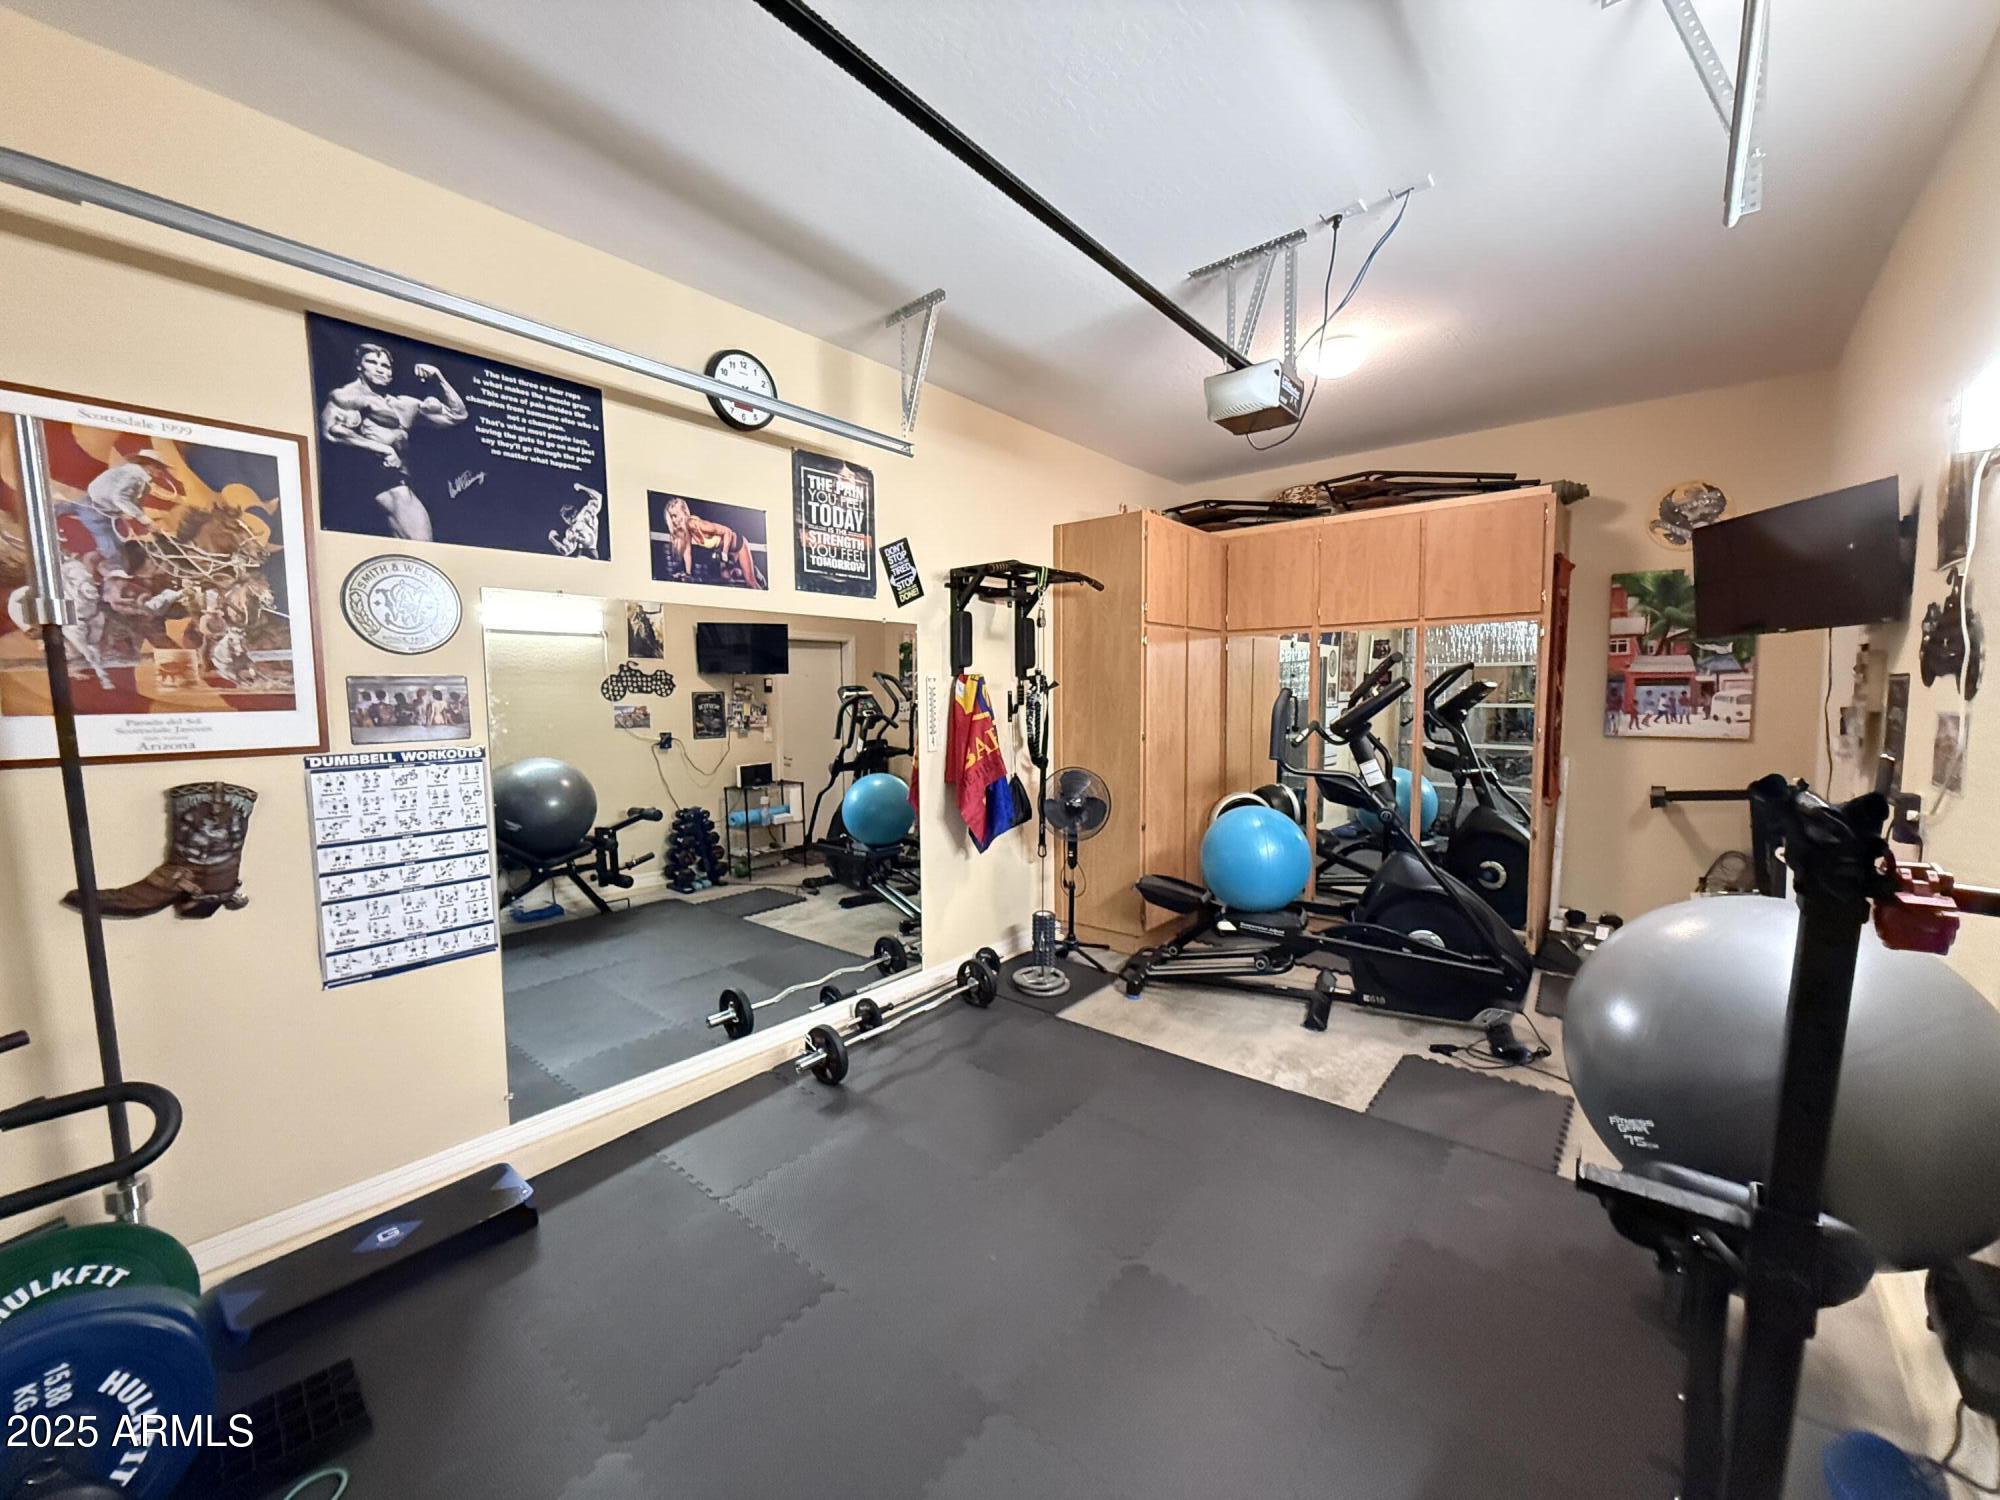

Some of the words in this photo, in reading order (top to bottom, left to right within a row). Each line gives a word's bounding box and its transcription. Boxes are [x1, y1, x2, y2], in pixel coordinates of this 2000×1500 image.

[484, 369, 500, 379] The
[482, 379, 503, 390] what
[531, 391, 543, 400] the
[465, 396, 505, 409] champion
[481, 388, 498, 398] This
[574, 410, 586, 419] the
[78, 407, 153, 429] Scottsdale
[161, 423, 192, 435] 1999
[504, 431, 517, 440] the
[807, 474, 832, 493] THE
[835, 481, 864, 501] PAIN
[808, 488, 836, 506] YOU
[841, 496, 864, 512] FEEL
[808, 502, 864, 532] TODAY
[808, 530, 865, 551] STRENGTH
[884, 542, 904, 556] DON'T
[808, 543, 837, 558] YOU
[841, 548, 864, 563] FEEL
[888, 550, 906, 564] STOP
[810, 555, 866, 573] TOMORROW
[891, 563, 910, 576] TIRED
[358, 564, 388, 589] SMITH
[392, 563, 398, 571] &
[897, 577, 914, 590] STOP
[137, 742, 196, 751] Arizona
[308, 752, 396, 768] DUMBBELL
[400, 748, 482, 762] WORKOUTS
[13, 1382, 39, 1415] KG
